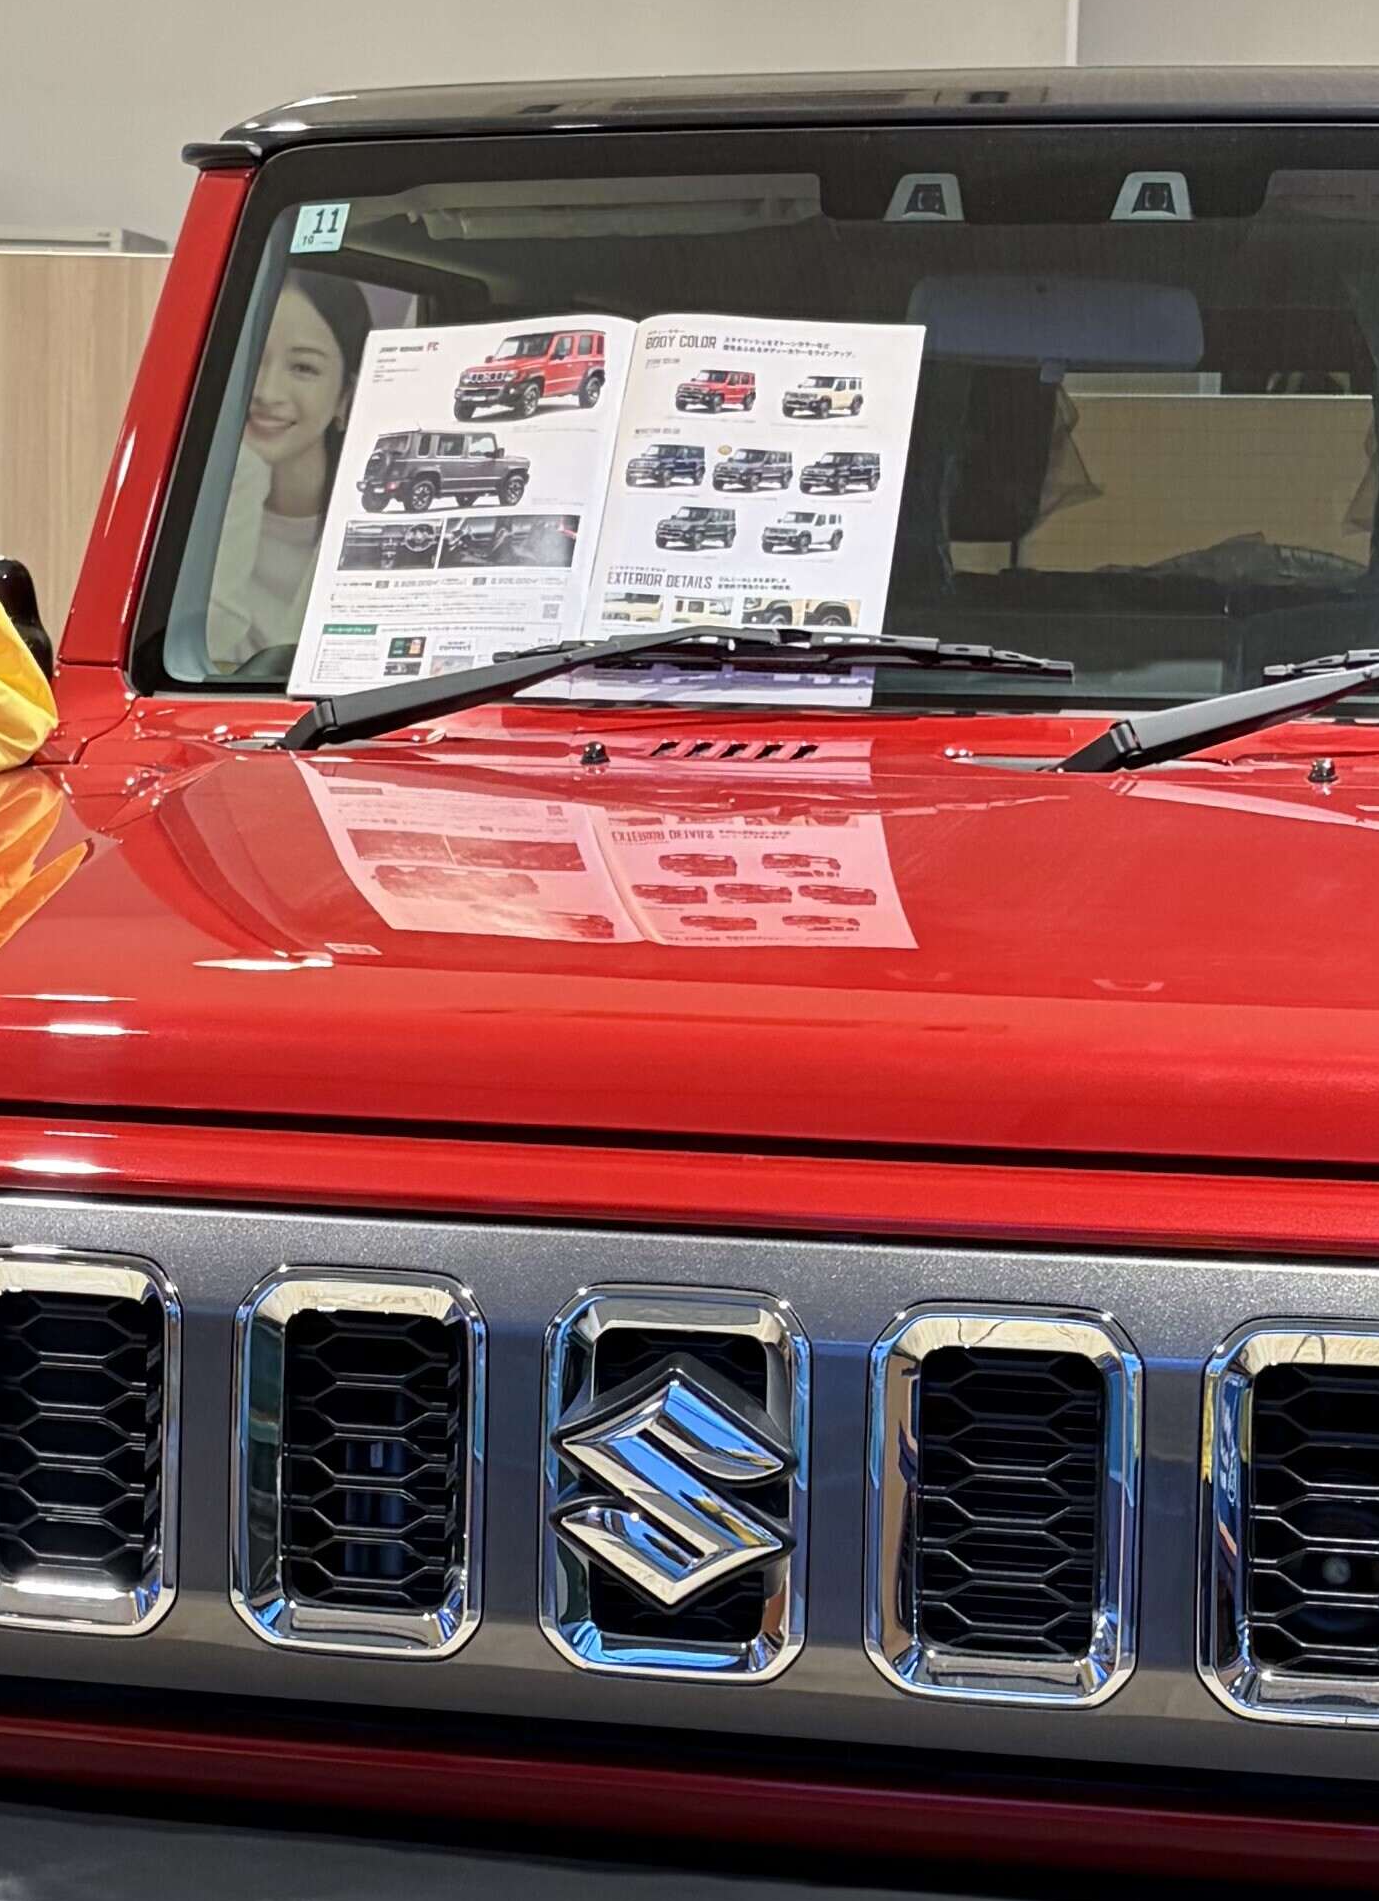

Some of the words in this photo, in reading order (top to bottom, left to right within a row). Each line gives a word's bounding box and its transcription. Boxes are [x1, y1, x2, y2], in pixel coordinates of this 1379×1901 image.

[312, 208, 339, 234] 11
[645, 335, 677, 350] BODY
[679, 335, 717, 349] COLOR
[606, 571, 663, 586] EXTERIOR
[665, 574, 713, 590] DETAILS
